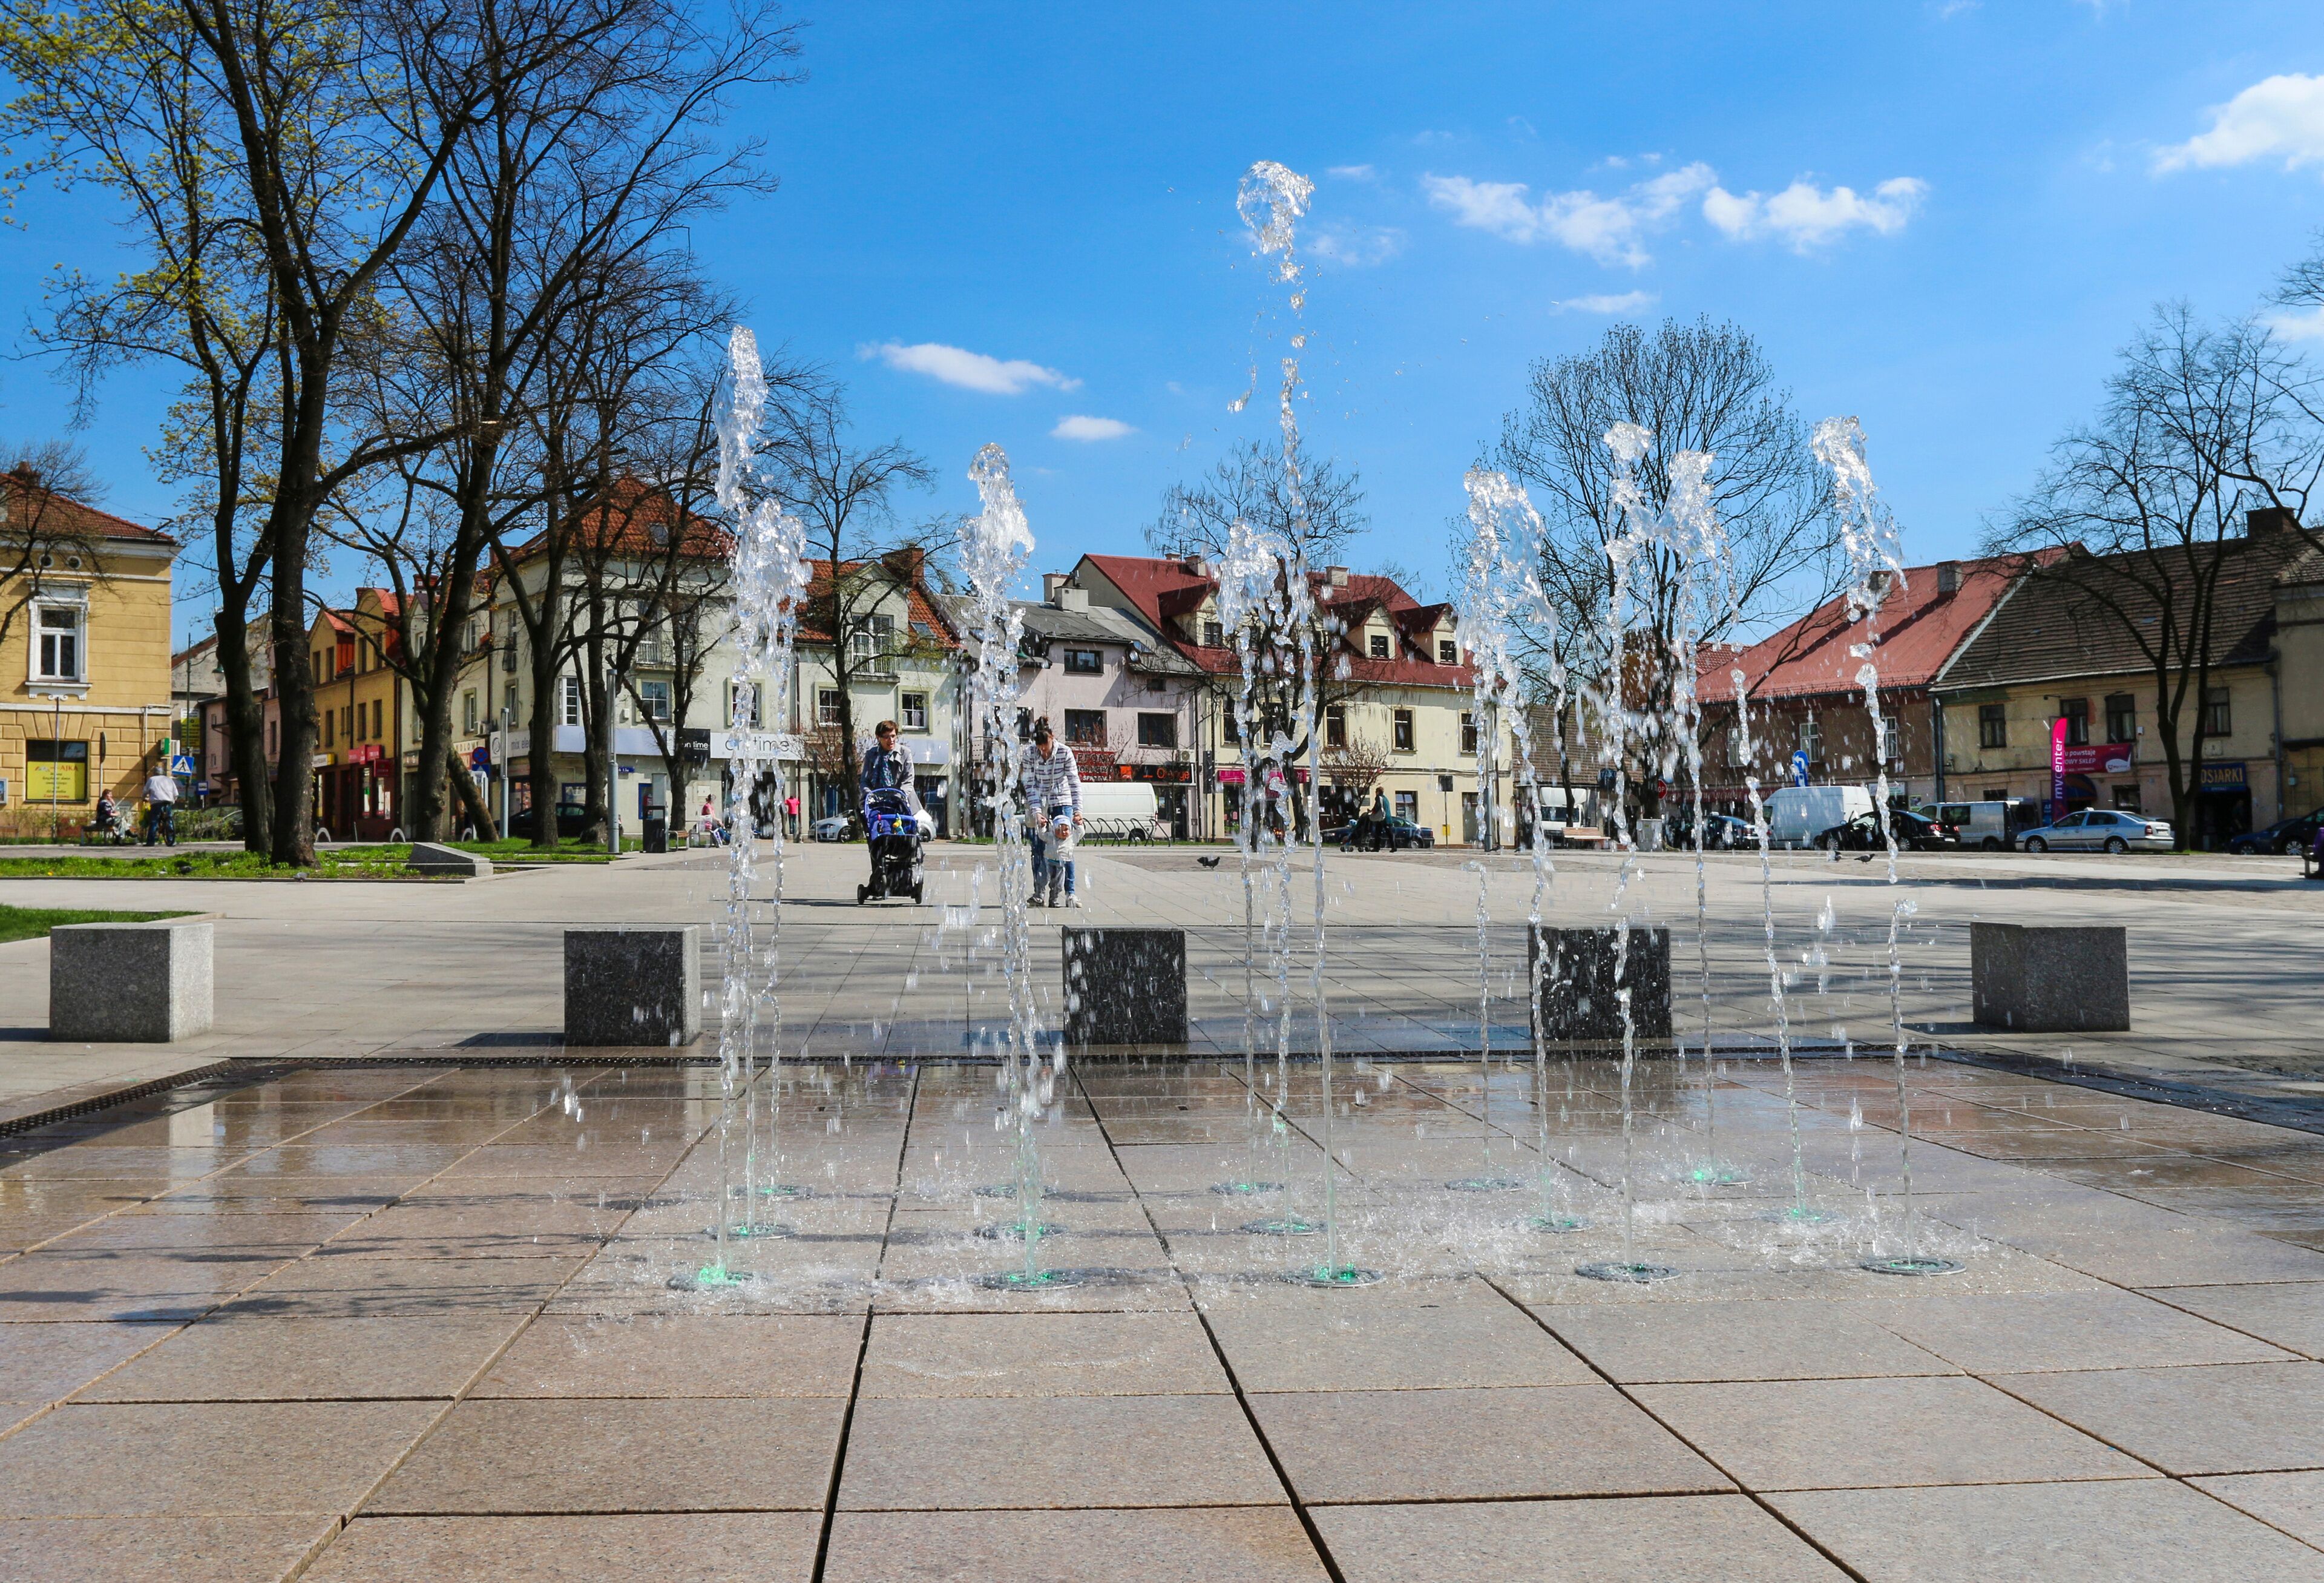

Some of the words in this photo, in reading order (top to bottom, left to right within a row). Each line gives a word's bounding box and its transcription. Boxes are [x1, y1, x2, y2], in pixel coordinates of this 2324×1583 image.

[753, 736, 789, 751] time
[2069, 749, 2096, 757] powstaje
[2055, 738, 2063, 798] mycenter
[2200, 768, 2244, 783] OSIARKI
